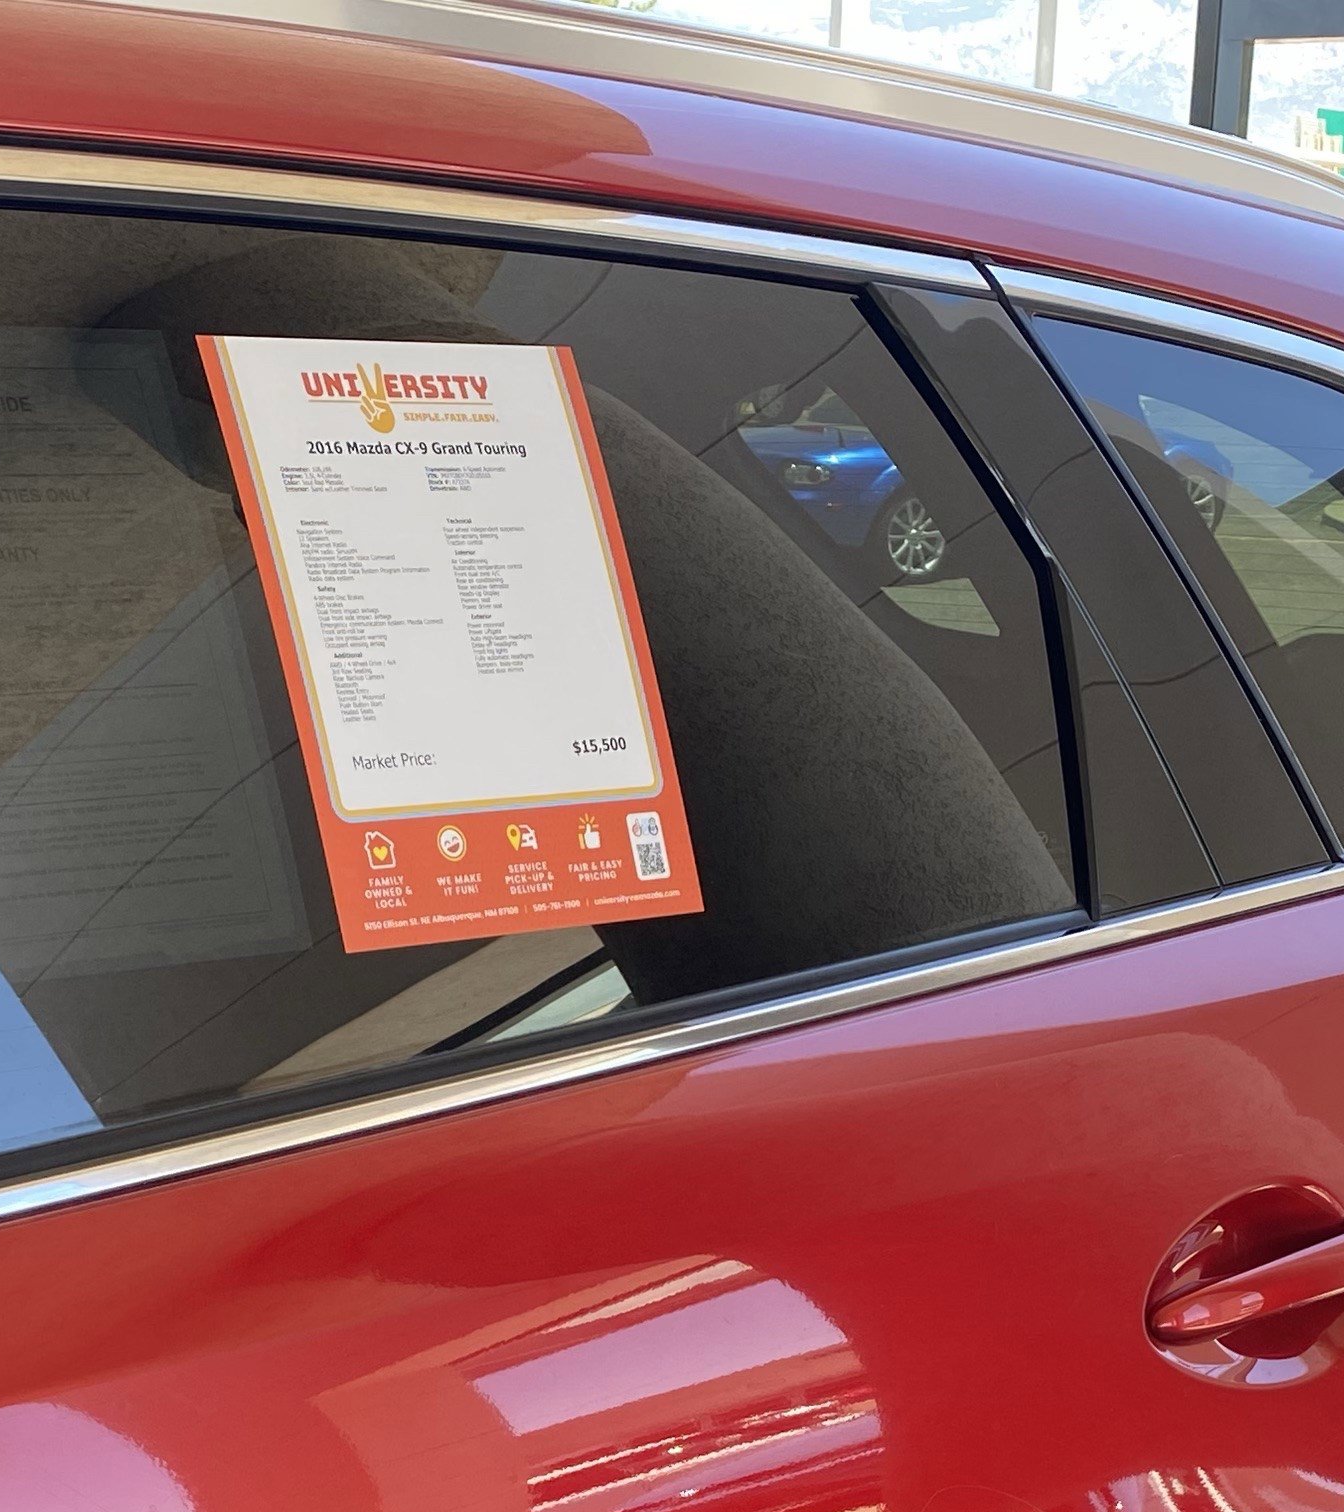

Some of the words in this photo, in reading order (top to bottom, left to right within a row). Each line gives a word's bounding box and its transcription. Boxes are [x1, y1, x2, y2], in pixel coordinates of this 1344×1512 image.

[301, 363, 488, 400] UNIVERSITY
[306, 441, 341, 454] 2016
[347, 441, 391, 455] Mazda
[395, 442, 427, 455] CX-9
[432, 442, 472, 455] Grand
[475, 442, 527, 457] Touring
[46, 487, 91, 504] ONLY
[572, 736, 627, 755] $15,500
[352, 752, 398, 770] Market
[402, 751, 437, 767] Price:
[508, 861, 547, 873] SERVICE
[568, 862, 589, 872] FAIR
[591, 861, 598, 870] &
[600, 859, 622, 870] EASY
[369, 875, 404, 887] FAMILY
[437, 876, 452, 886] WE
[455, 873, 481, 883] MAKE
[505, 873, 545, 884] PICK-UP
[548, 872, 555, 880] &
[578, 870, 617, 882] PRICING
[365, 887, 403, 899] OWNED
[406, 885, 413, 895] &
[444, 887, 453, 896] IT
[456, 884, 478, 896] FUN!
[510, 882, 554, 895] DELIVERY
[375, 898, 407, 909] LOCAL
